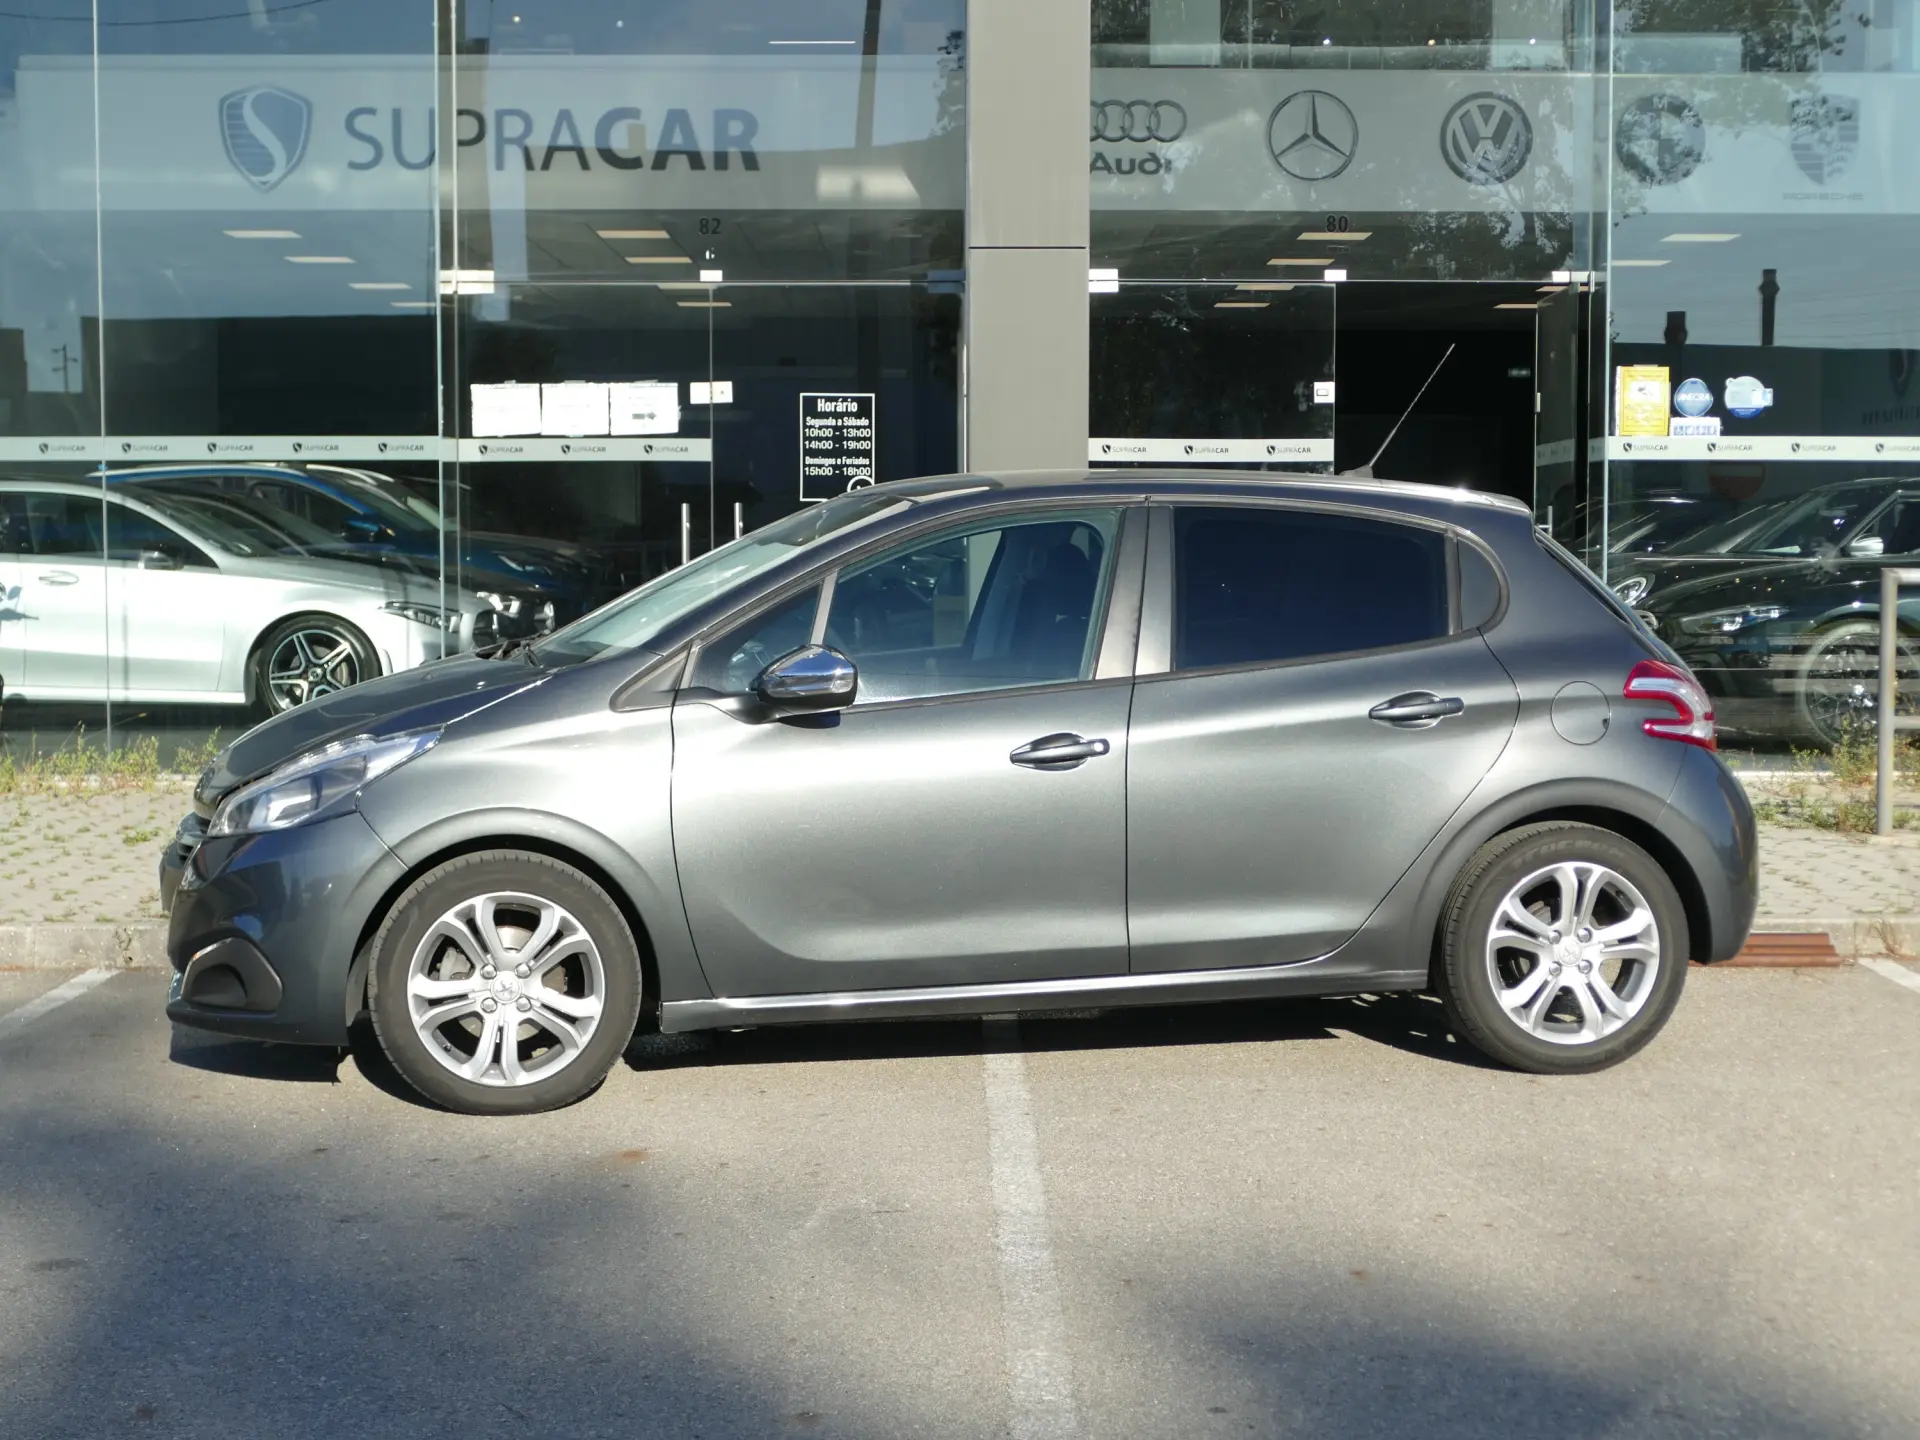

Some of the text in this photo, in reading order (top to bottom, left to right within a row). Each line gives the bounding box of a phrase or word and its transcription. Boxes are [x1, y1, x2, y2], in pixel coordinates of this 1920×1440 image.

[344, 107, 760, 171] SUPRACAR
[699, 217, 722, 235] 82
[1326, 215, 1348, 233] 80
[817, 398, 858, 412] Horário
[806, 417, 836, 427] Segunda
[843, 416, 869, 426] Sábado
[804, 428, 833, 437] 10h00
[842, 428, 871, 437] 13h00
[804, 440, 833, 449] 14h00
[842, 440, 871, 449] 19h00
[805, 456, 836, 466] Domingos
[842, 456, 869, 465] Feriados
[804, 467, 833, 476] 15h00
[842, 467, 871, 476] 18h00
